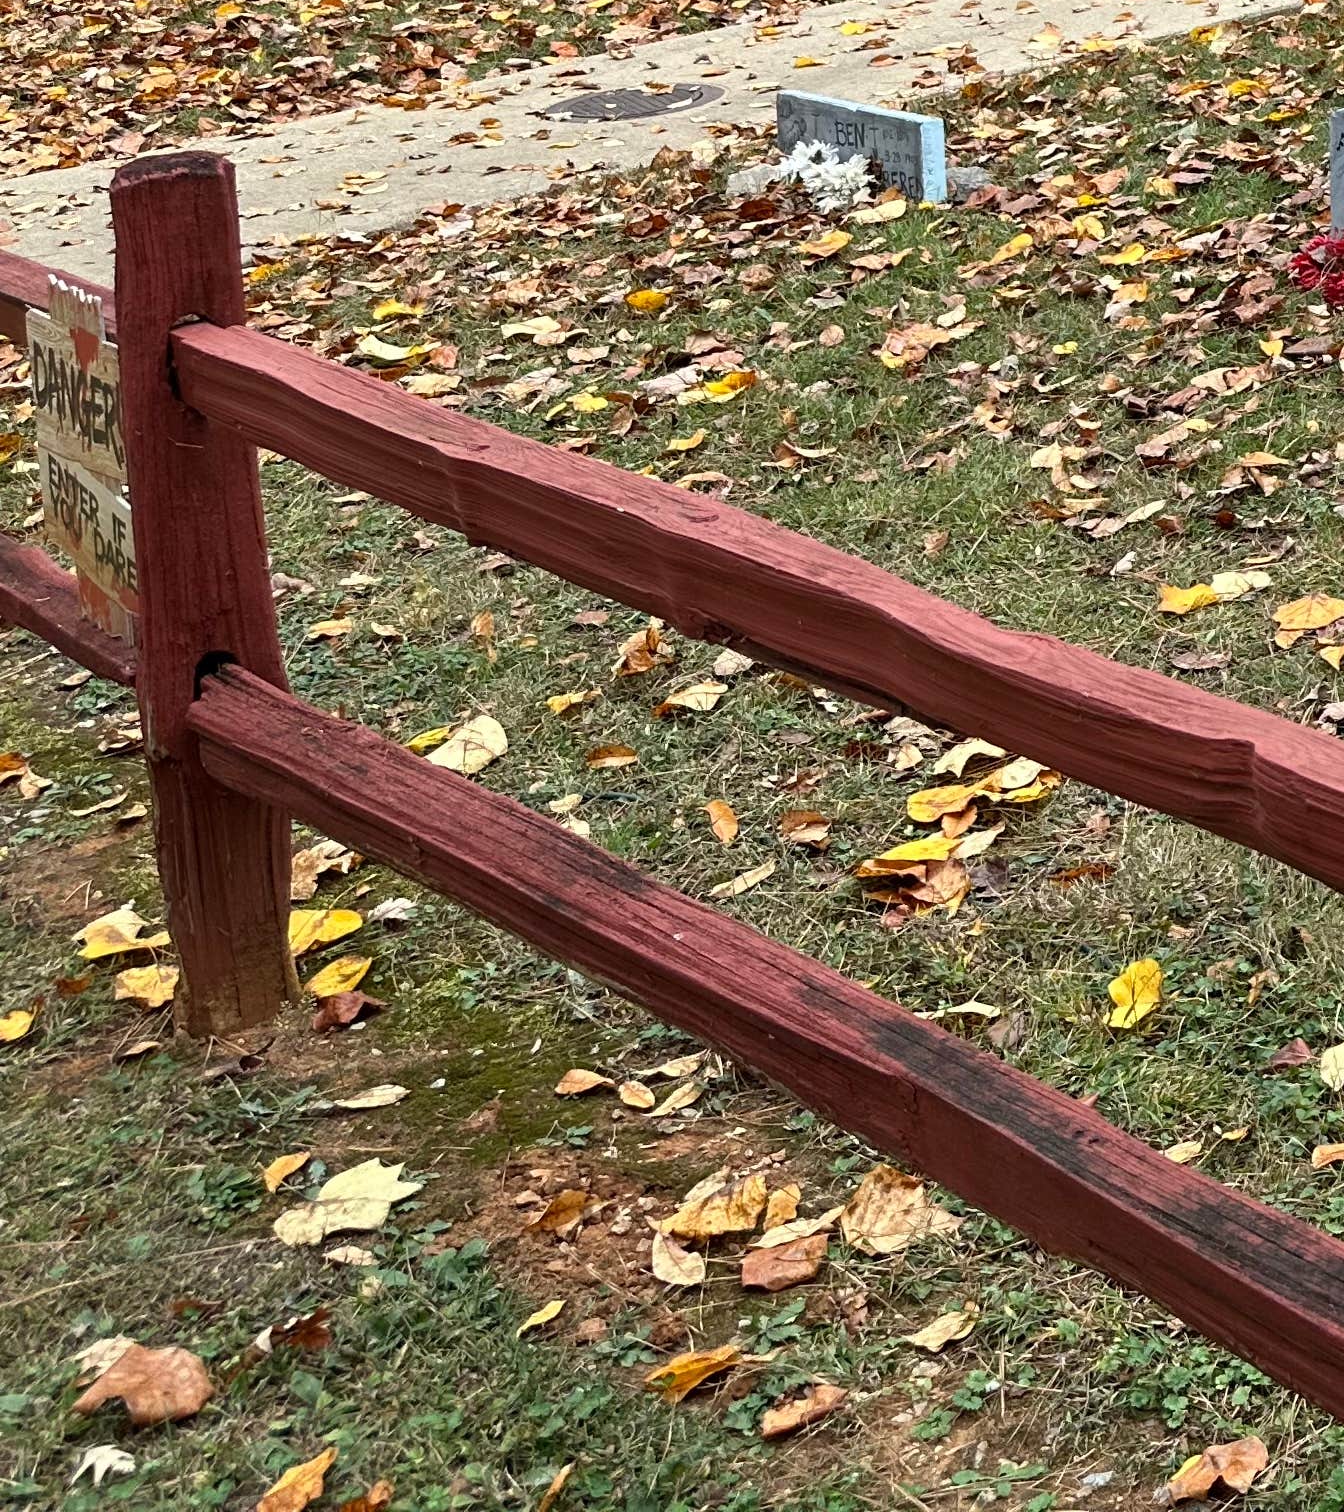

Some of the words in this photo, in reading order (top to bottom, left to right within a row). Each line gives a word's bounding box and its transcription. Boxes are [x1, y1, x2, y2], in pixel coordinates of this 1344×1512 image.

[47, 453, 101, 530] ENTER
[112, 511, 127, 545] IF
[49, 491, 87, 551] YOU
[92, 526, 138, 595] DARE
